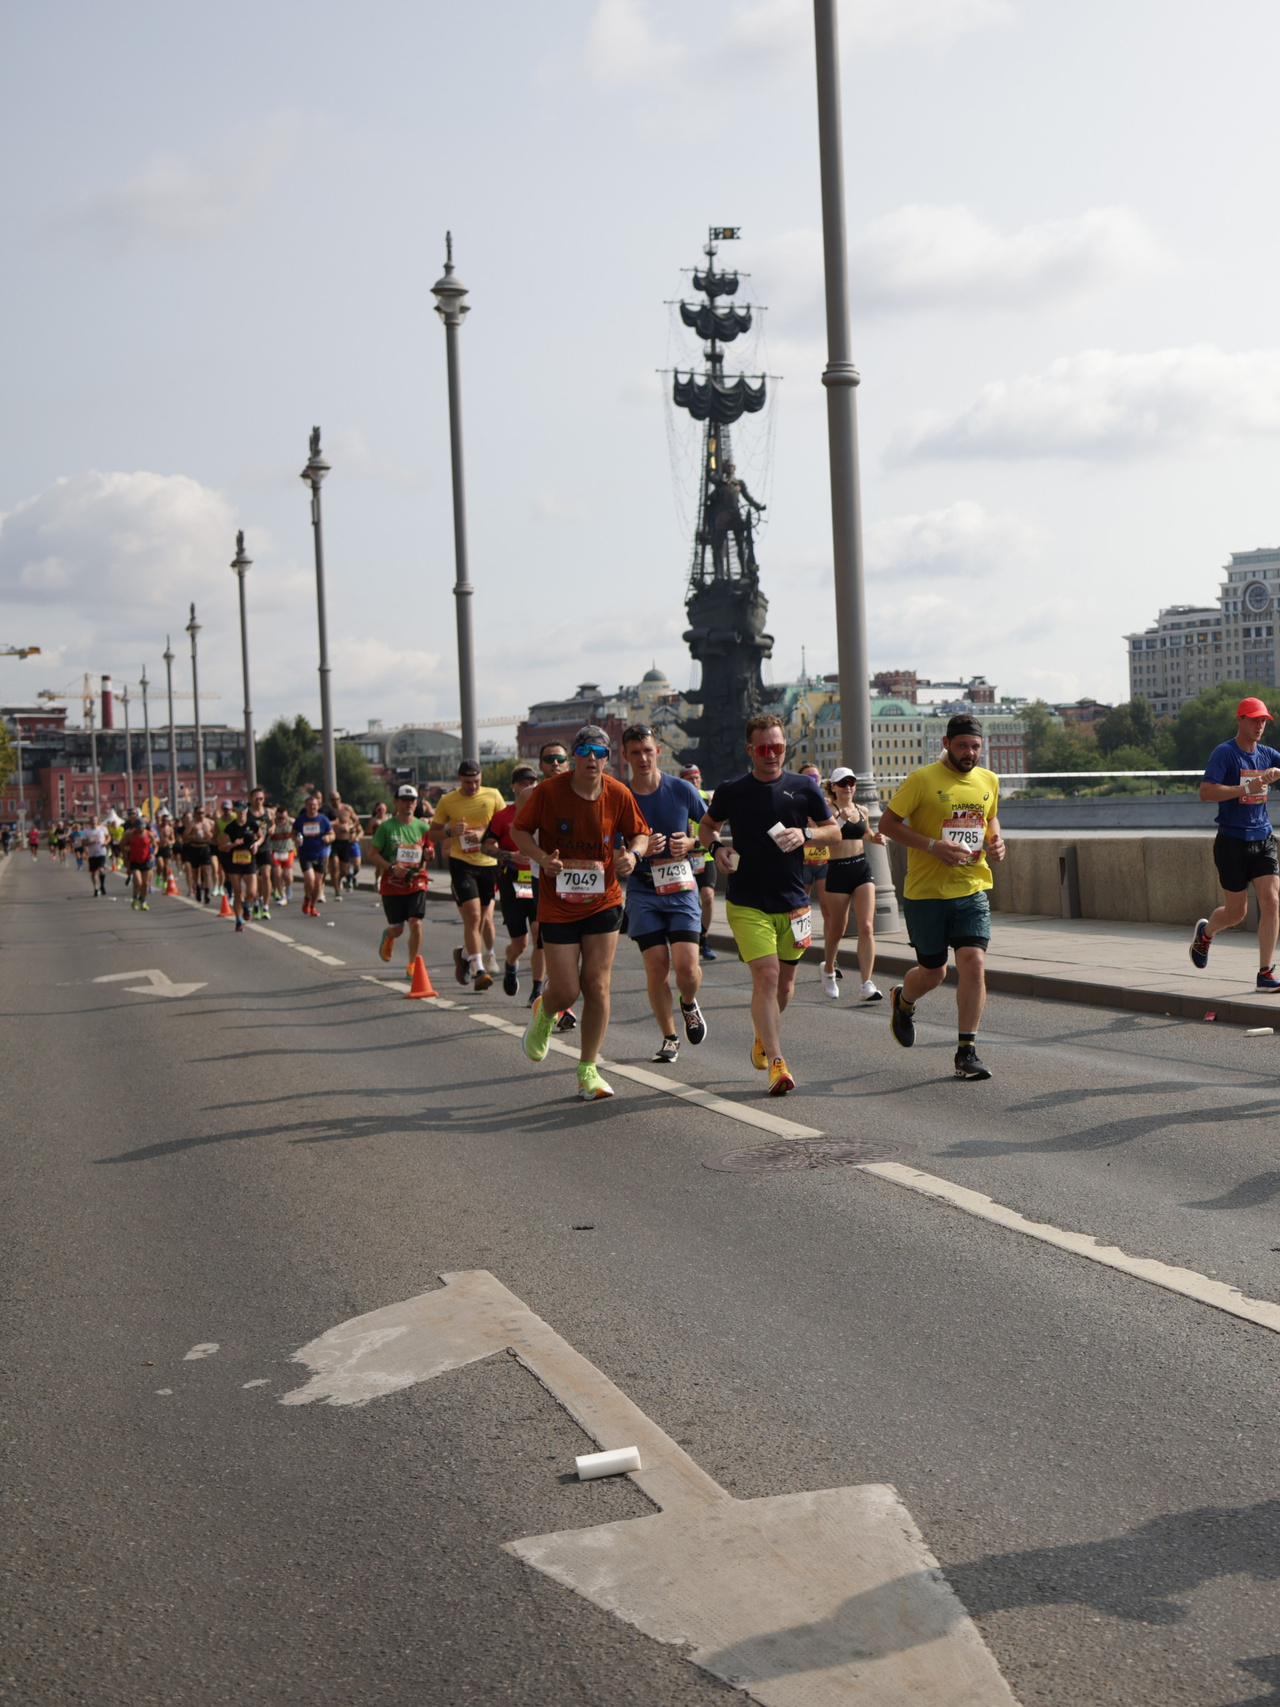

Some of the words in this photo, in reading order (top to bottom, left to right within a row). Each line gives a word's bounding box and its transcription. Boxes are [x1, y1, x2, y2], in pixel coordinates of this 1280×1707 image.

[949, 831, 978, 844] 7785
[658, 864, 688, 879] 7438
[563, 872, 598, 887] 7049
